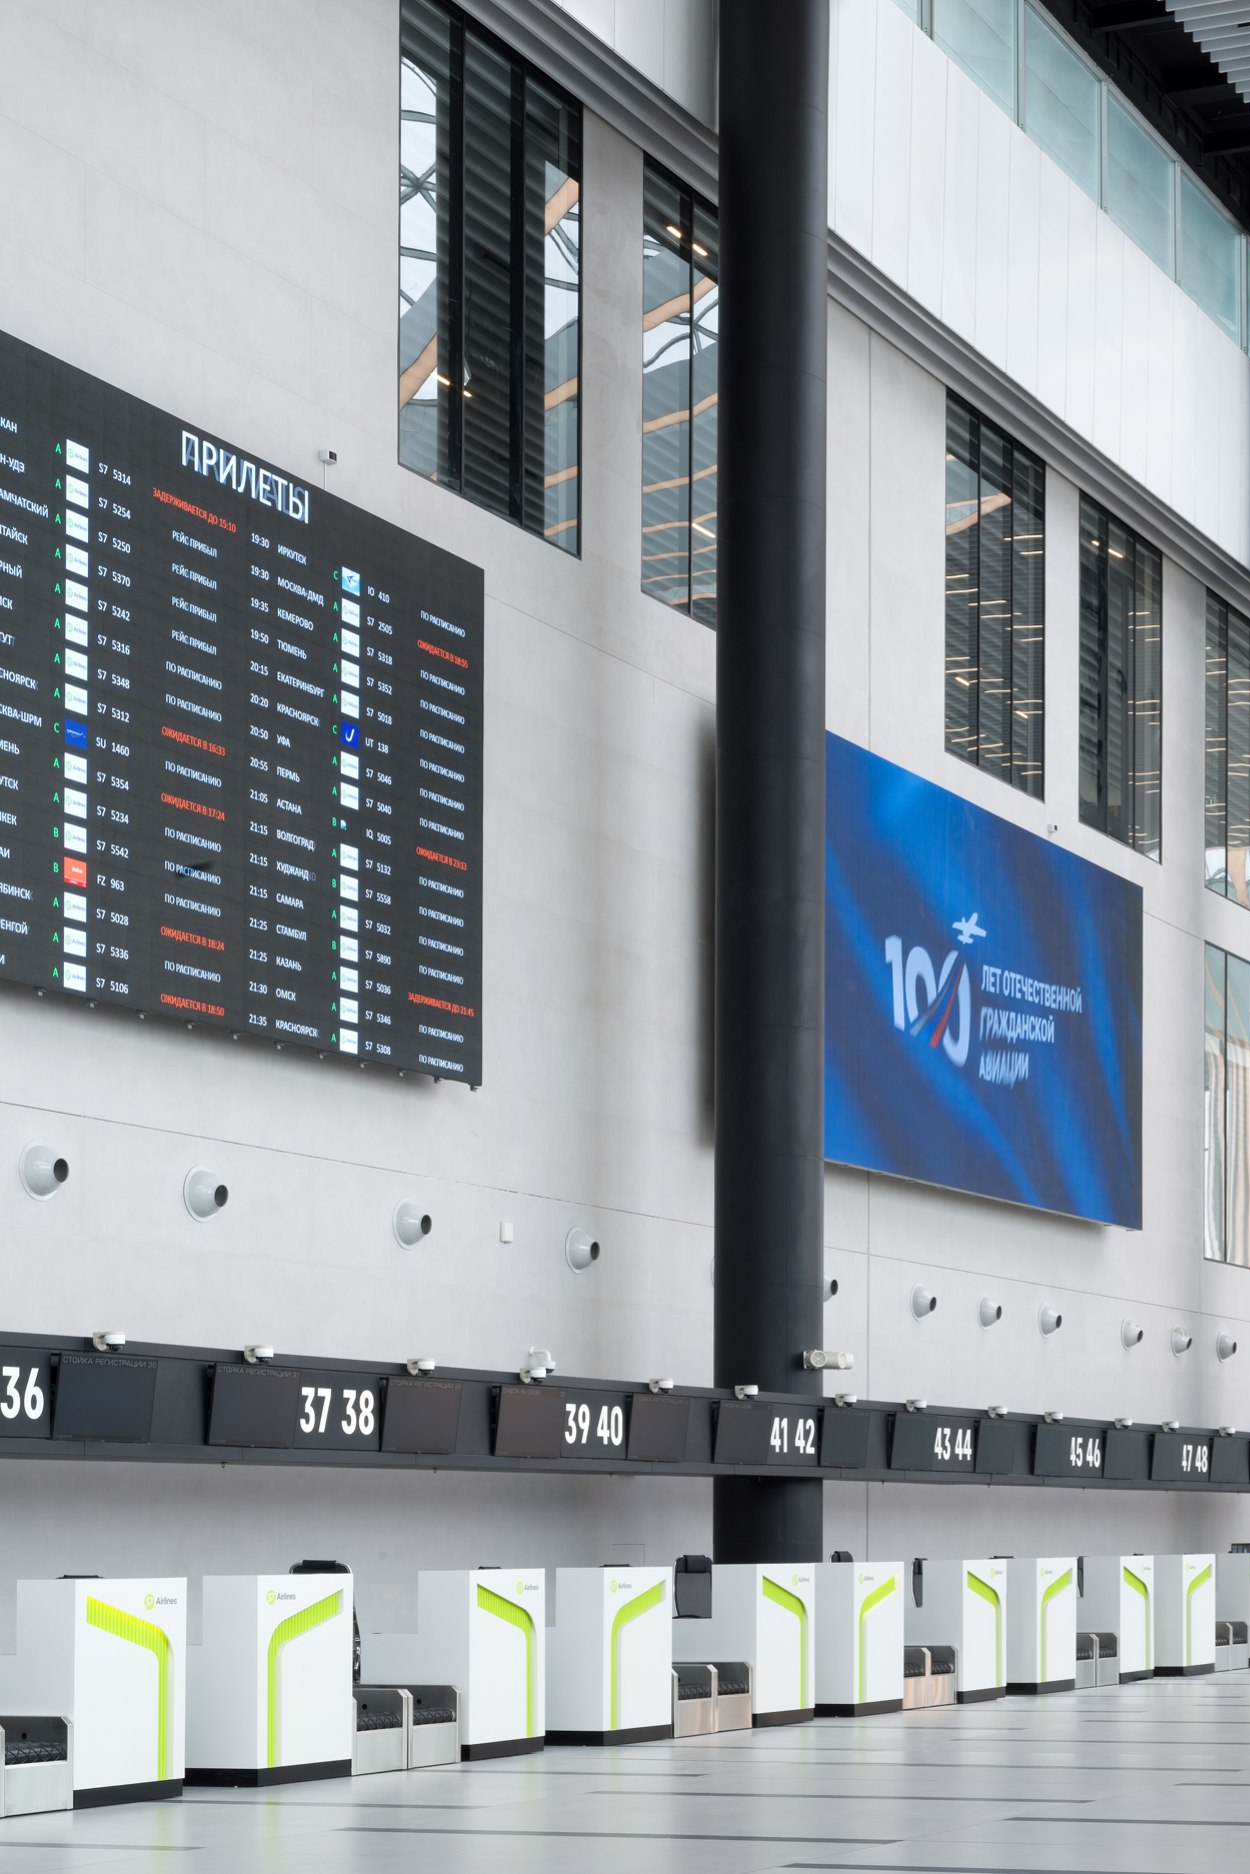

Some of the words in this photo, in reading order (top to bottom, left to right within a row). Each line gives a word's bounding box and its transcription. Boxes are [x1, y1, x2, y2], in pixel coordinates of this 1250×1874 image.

[99, 463, 108, 474] S7
[113, 469, 131, 485] 5314
[181, 430, 309, 524] ПРИЛЕТЫ
[99, 497, 108, 509] S7
[113, 503, 131, 519] 5254
[207, 513, 218, 525] ДО
[218, 518, 236, 533] 15:10
[98, 532, 107, 543] S7
[112, 537, 130, 553] 5250
[172, 530, 189, 545] РЕЙС
[189, 538, 217, 558] ПРИБЫЛ
[251, 533, 269, 548] 19:30
[278, 544, 306, 565] ИРКУТСК
[98, 565, 107, 577] S7
[112, 571, 130, 587] 5370
[172, 563, 189, 578] РЕЙС
[189, 571, 217, 590] ПРИБЫЛ
[251, 565, 269, 580] 19:30
[278, 576, 324, 607] МОСКВА-ДМД
[368, 586, 375, 596] IO
[98, 600, 107, 611] S7
[112, 605, 130, 621] 5242
[172, 596, 189, 611] РЕЙС
[189, 604, 217, 623] ПРИБЫЛ
[251, 597, 269, 612] 19:35
[278, 608, 313, 631] КЕМЕРОВО
[367, 616, 374, 626] S7
[98, 634, 107, 646] S7
[112, 640, 130, 655] 5316
[172, 630, 189, 644] РЕЙС
[189, 637, 216, 655] ПРИБЫЛ
[251, 629, 269, 644] 19:50
[277, 639, 307, 660] ТЮМЕНЬ
[166, 661, 176, 672] ПО
[177, 665, 222, 690] РАСПИСАНИЮ
[250, 661, 268, 676] 20:15
[98, 669, 107, 680] S7
[112, 674, 130, 689] 5348
[277, 671, 324, 698] ЕКАТЕРИНБУРГ
[166, 694, 176, 705] ПО
[177, 698, 222, 722] РАСПИСАНИЮ
[250, 693, 268, 708] 20:20
[97, 703, 106, 714] S7
[112, 708, 129, 723] 5312
[277, 703, 318, 727] КРАСНОЯРСК
[366, 707, 374, 717] S7
[162, 726, 202, 748] ОЖИДАЕТСЯ
[250, 725, 268, 740] 20:50
[277, 734, 290, 748] УФА
[365, 737, 374, 748] UT
[96, 737, 106, 749] SU
[112, 742, 129, 757] 1460
[250, 757, 268, 771] 20:55
[97, 771, 106, 783] S7
[111, 776, 129, 791] 5354
[165, 761, 176, 772] ПО
[177, 765, 221, 788] РАСПИСАНИЮ
[277, 766, 300, 783] ПЕРМЬ
[161, 793, 201, 813] ОЖИДАЕТСЯ
[250, 789, 268, 803] 21:05
[97, 805, 106, 816] S7
[111, 810, 129, 824] 5234
[276, 798, 302, 815] АСТАНА
[250, 821, 268, 835] 21:15
[366, 829, 373, 840] IQ
[97, 840, 106, 851] S7
[111, 844, 128, 858] 5542
[165, 827, 175, 838] ПО
[176, 831, 221, 852] РАСПИСАНИЮ
[277, 829, 314, 852] ВОЛГОГРАД
[250, 853, 268, 867] 21:15
[165, 861, 175, 872] ПО
[176, 864, 221, 885] РАСПИСАНИЮ
[276, 861, 309, 880] ХУДЖАНД
[97, 874, 106, 886] FZ
[110, 878, 124, 891] 963
[250, 885, 267, 899] 21:15
[165, 893, 175, 904] ПО
[176, 897, 221, 917] РАСПИСАНИЮ
[276, 893, 304, 909] САМАРА
[96, 908, 106, 919] S7
[111, 912, 129, 926] 5028
[250, 917, 267, 931] 21:25
[161, 926, 201, 944] ОЖИДАЕТСЯ
[276, 924, 306, 941] СТАМБУЛ
[96, 943, 105, 954] S7
[110, 946, 129, 960] 5336
[249, 949, 267, 962] 21:25
[365, 950, 373, 959] S7
[165, 960, 175, 971] ПО
[176, 963, 221, 983] РАСПИСАНИЮ
[276, 956, 302, 971] КАЗАНЬ
[96, 977, 105, 988] S7
[110, 981, 128, 994] 5106
[249, 981, 267, 994] 21:30
[276, 988, 296, 1001] ОМСК
[981, 965, 1001, 994] ЛЕТ
[1003, 970, 1082, 1013] ОТЕЧЕСТВЕННОЙ
[160, 993, 200, 1011] ОЖИДАЕТСЯ
[885, 934, 971, 1067] 100
[249, 1013, 267, 1026] 21:35
[276, 1019, 318, 1038] КРАСНОЯРСК
[980, 1008, 1055, 1043] ГРАЖДАНСКОЙ
[979, 1051, 1029, 1086] АВИАЦИИ
[0, 1366, 44, 1419] 36
[300, 1387, 331, 1433] 37
[341, 1389, 374, 1435] 38
[565, 1404, 590, 1444] 39
[597, 1406, 623, 1446] 40
[770, 1417, 788, 1453] 41
[795, 1419, 815, 1454] 42
[934, 1428, 951, 1460] 43
[955, 1429, 972, 1460] 44
[1070, 1437, 1083, 1467] 45
[1086, 1438, 1100, 1467] 46
[1182, 1445, 1193, 1471] 47
[1195, 1446, 1208, 1472] 48
[156, 1597, 178, 1605] Airlines
[277, 1592, 296, 1601] Airlines
